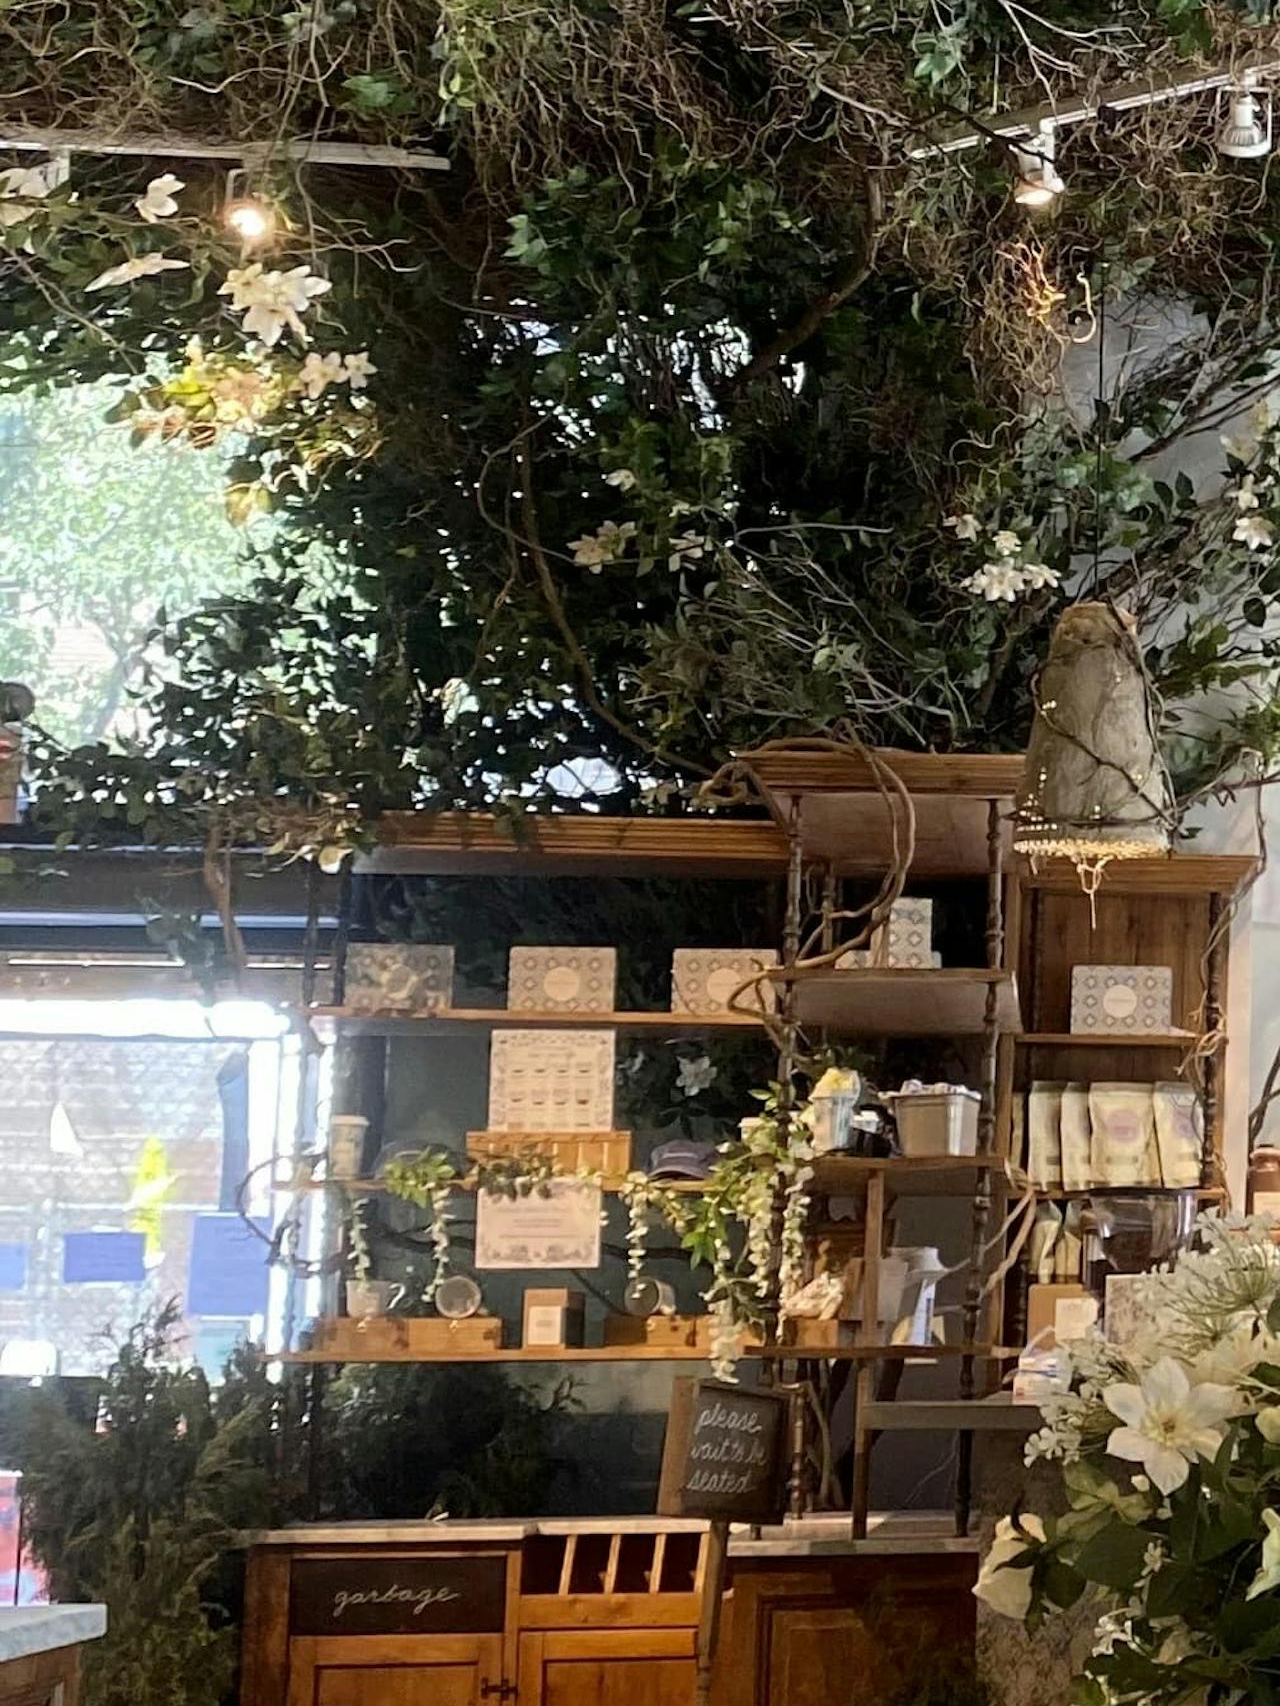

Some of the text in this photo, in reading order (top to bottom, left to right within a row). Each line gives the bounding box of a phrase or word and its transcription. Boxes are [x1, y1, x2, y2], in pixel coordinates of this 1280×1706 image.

[694, 1403, 762, 1435] please
[686, 1470, 758, 1493] seated
[333, 1584, 460, 1617] garbage
